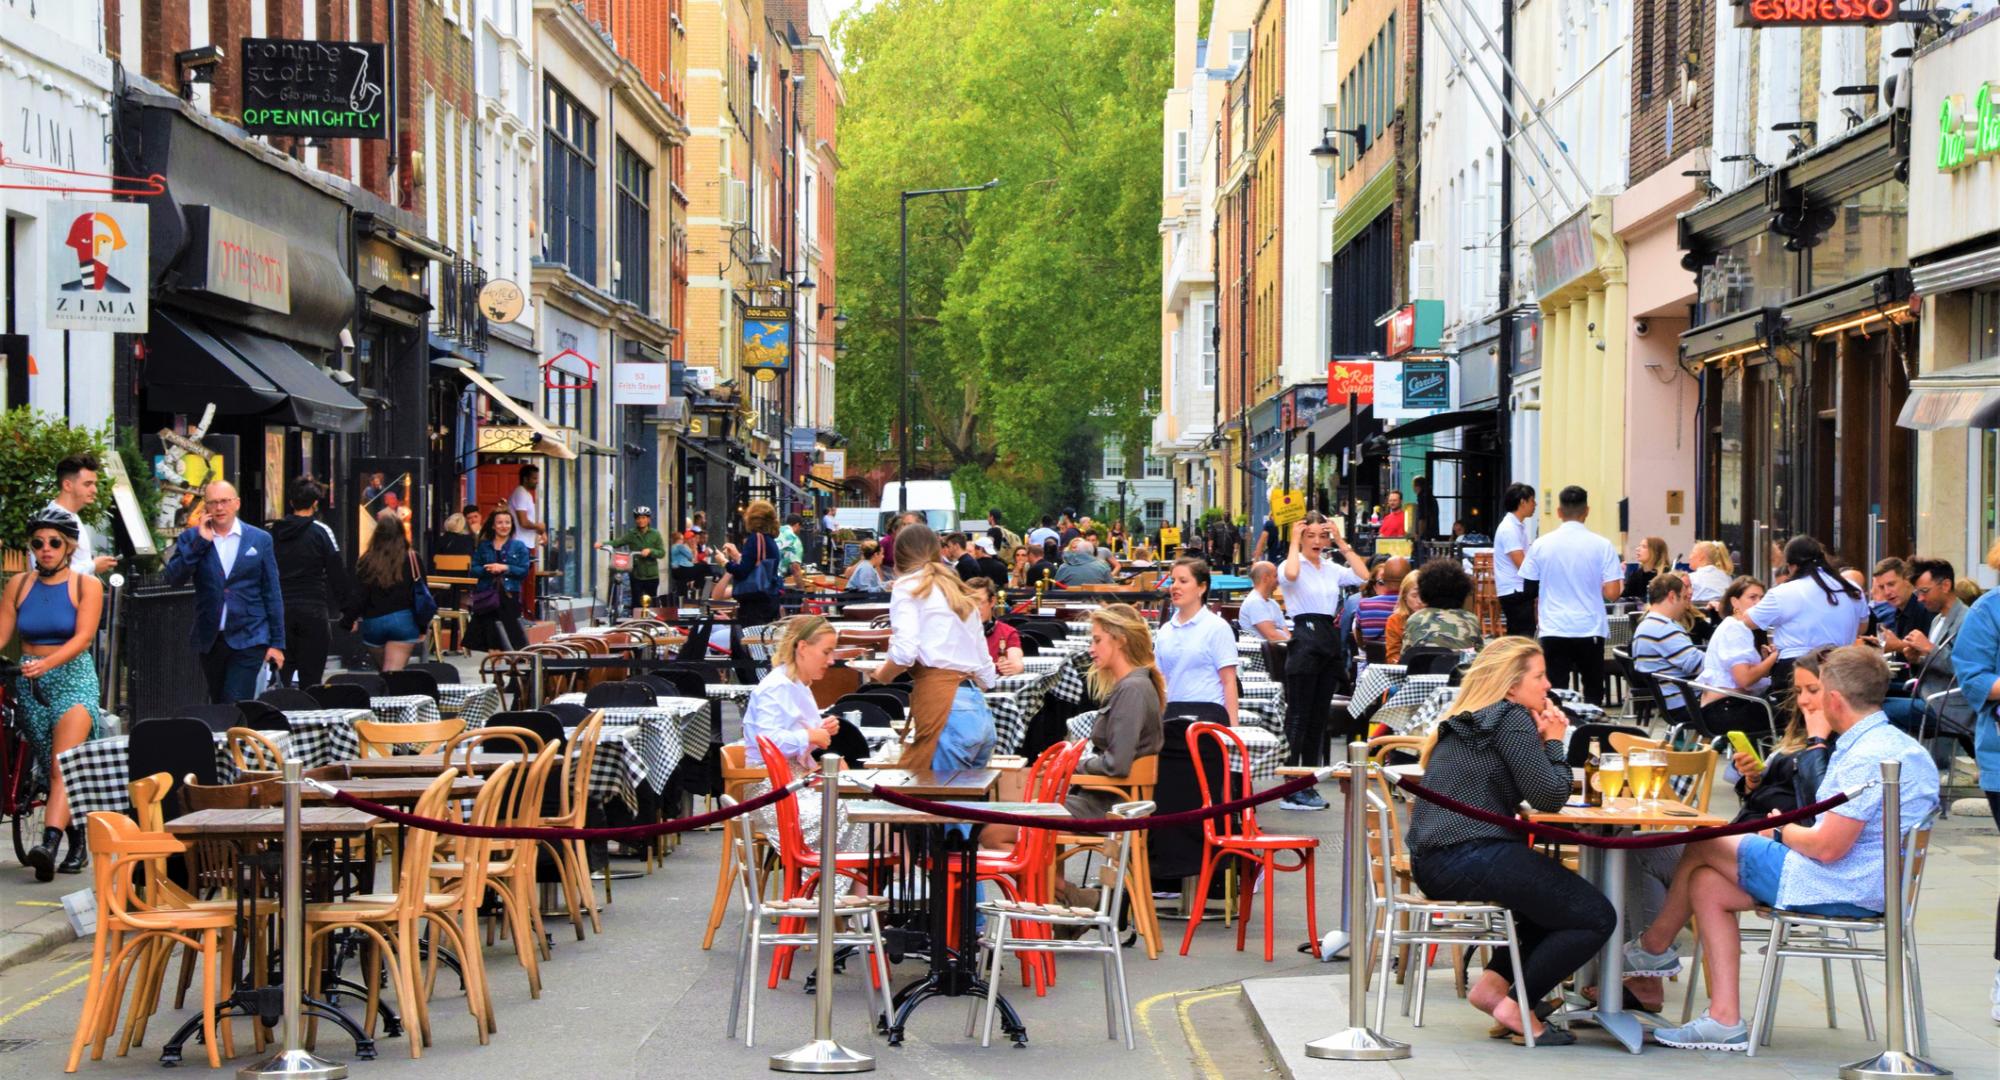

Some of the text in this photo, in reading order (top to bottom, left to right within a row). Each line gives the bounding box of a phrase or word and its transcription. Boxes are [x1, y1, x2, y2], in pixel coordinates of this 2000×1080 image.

[247, 42, 341, 62] ronnie
[21, 106, 76, 172] ZIMA
[1936, 97, 1965, 168] Bar
[56, 297, 135, 315] ZIMA
[1348, 369, 1374, 385] Ras
[1337, 380, 1374, 396] Sayan
[483, 427, 564, 440] COCKTS
